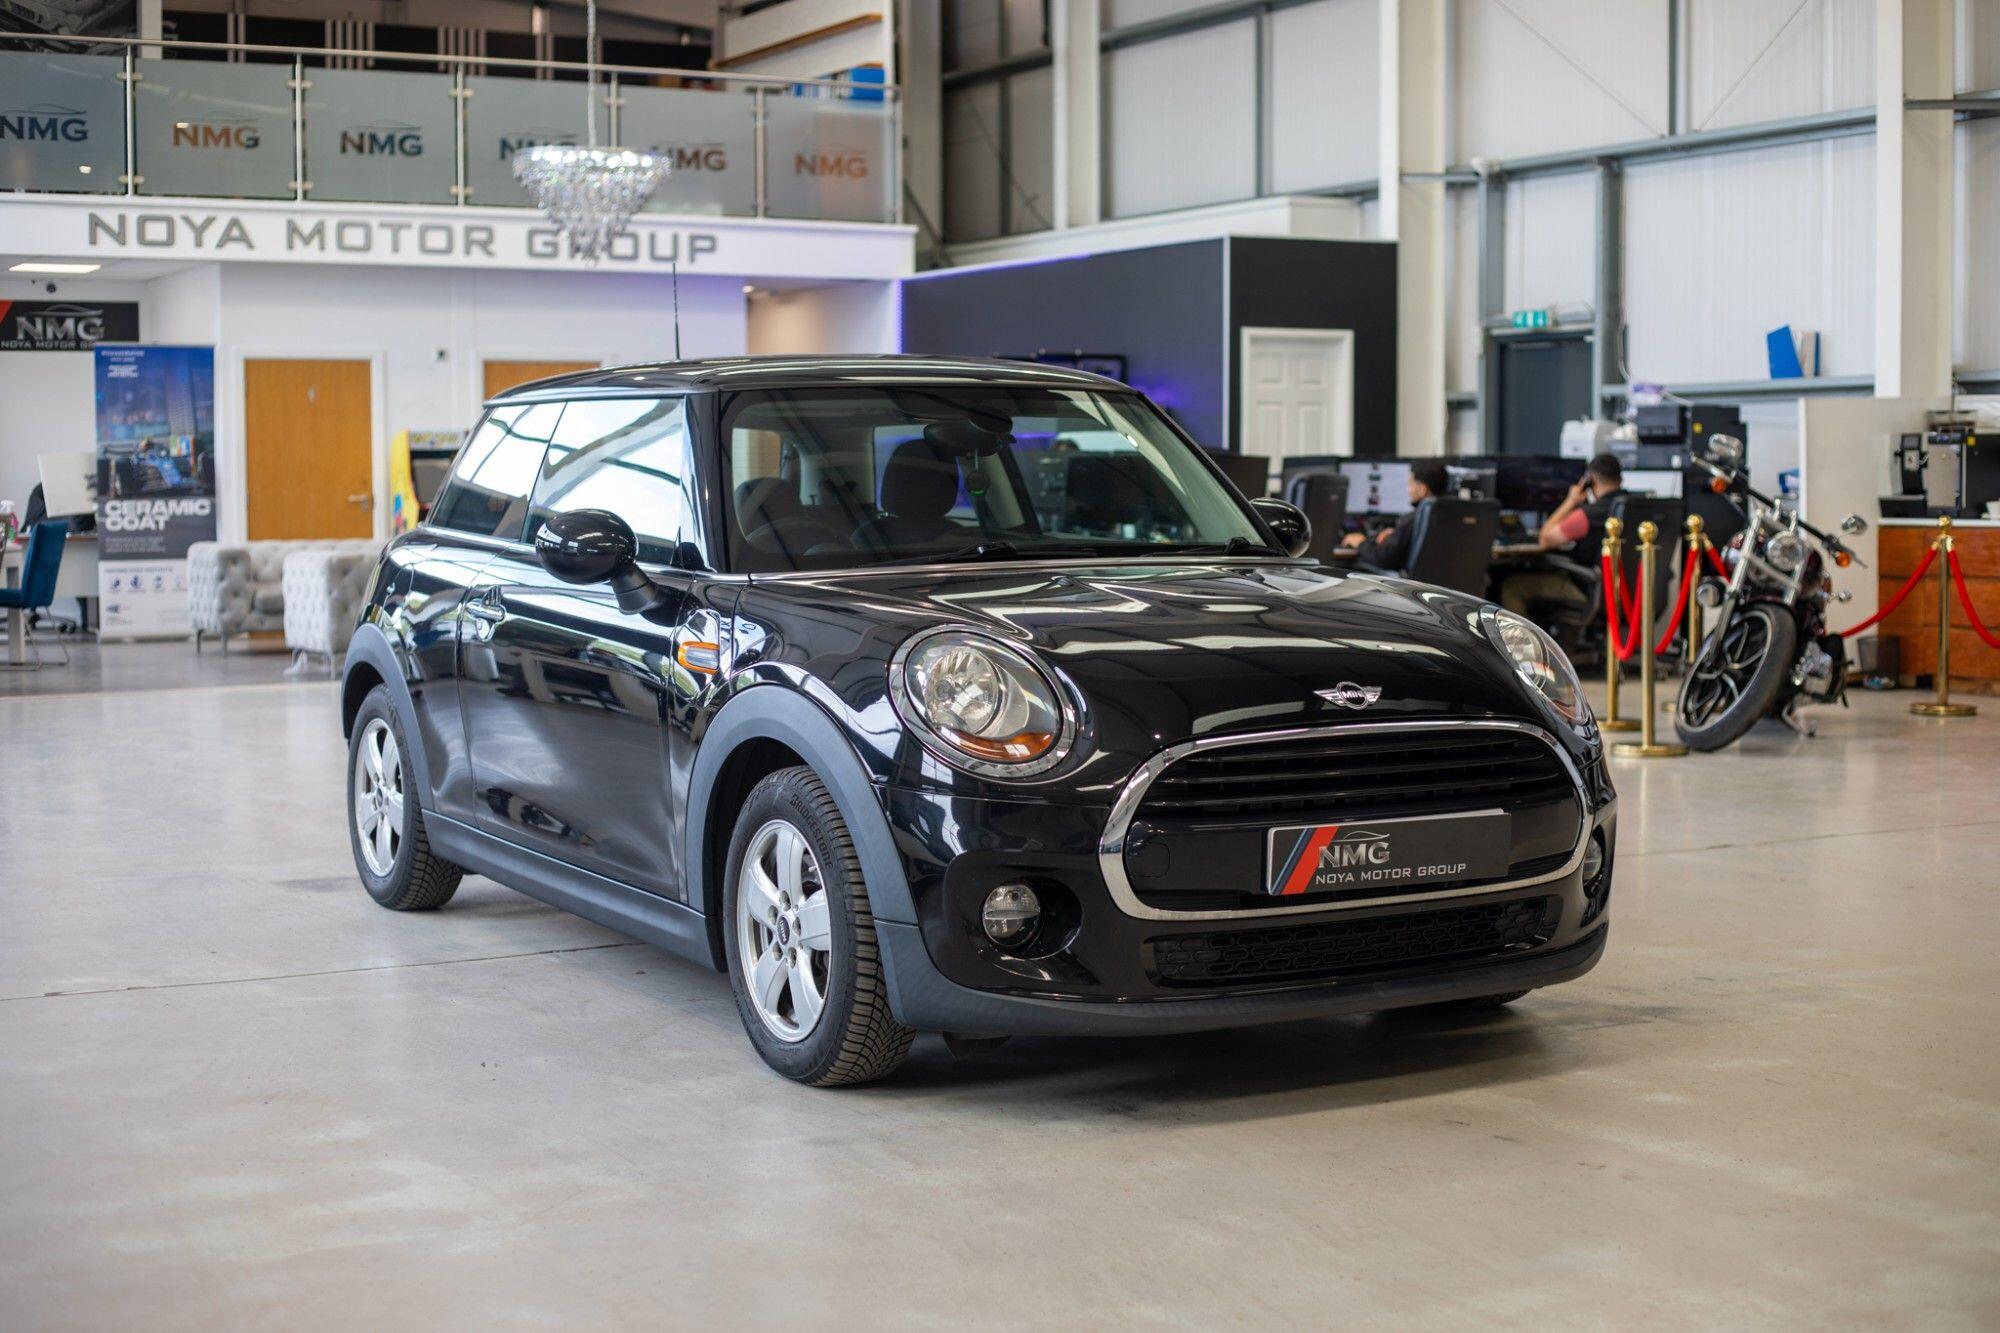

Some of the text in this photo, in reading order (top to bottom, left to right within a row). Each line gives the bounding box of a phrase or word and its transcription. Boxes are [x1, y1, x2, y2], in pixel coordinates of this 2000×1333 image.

[0, 115, 88, 142] NMG
[173, 123, 260, 150] NMG
[340, 131, 424, 157] NMG
[650, 146, 727, 171] MG
[794, 152, 868, 179] NMG
[88, 213, 255, 249] NOYA
[286, 218, 495, 258] MOTOR
[16, 316, 104, 341] NMG
[36, 340, 77, 351] MOTOR
[105, 499, 211, 517] CERAMIC
[105, 514, 166, 531] COAT
[789, 793, 834, 870] BRIDGESTONE
[1318, 841, 1390, 869] NMG
[1315, 863, 1467, 885] NOYA MOTOR GROUP
